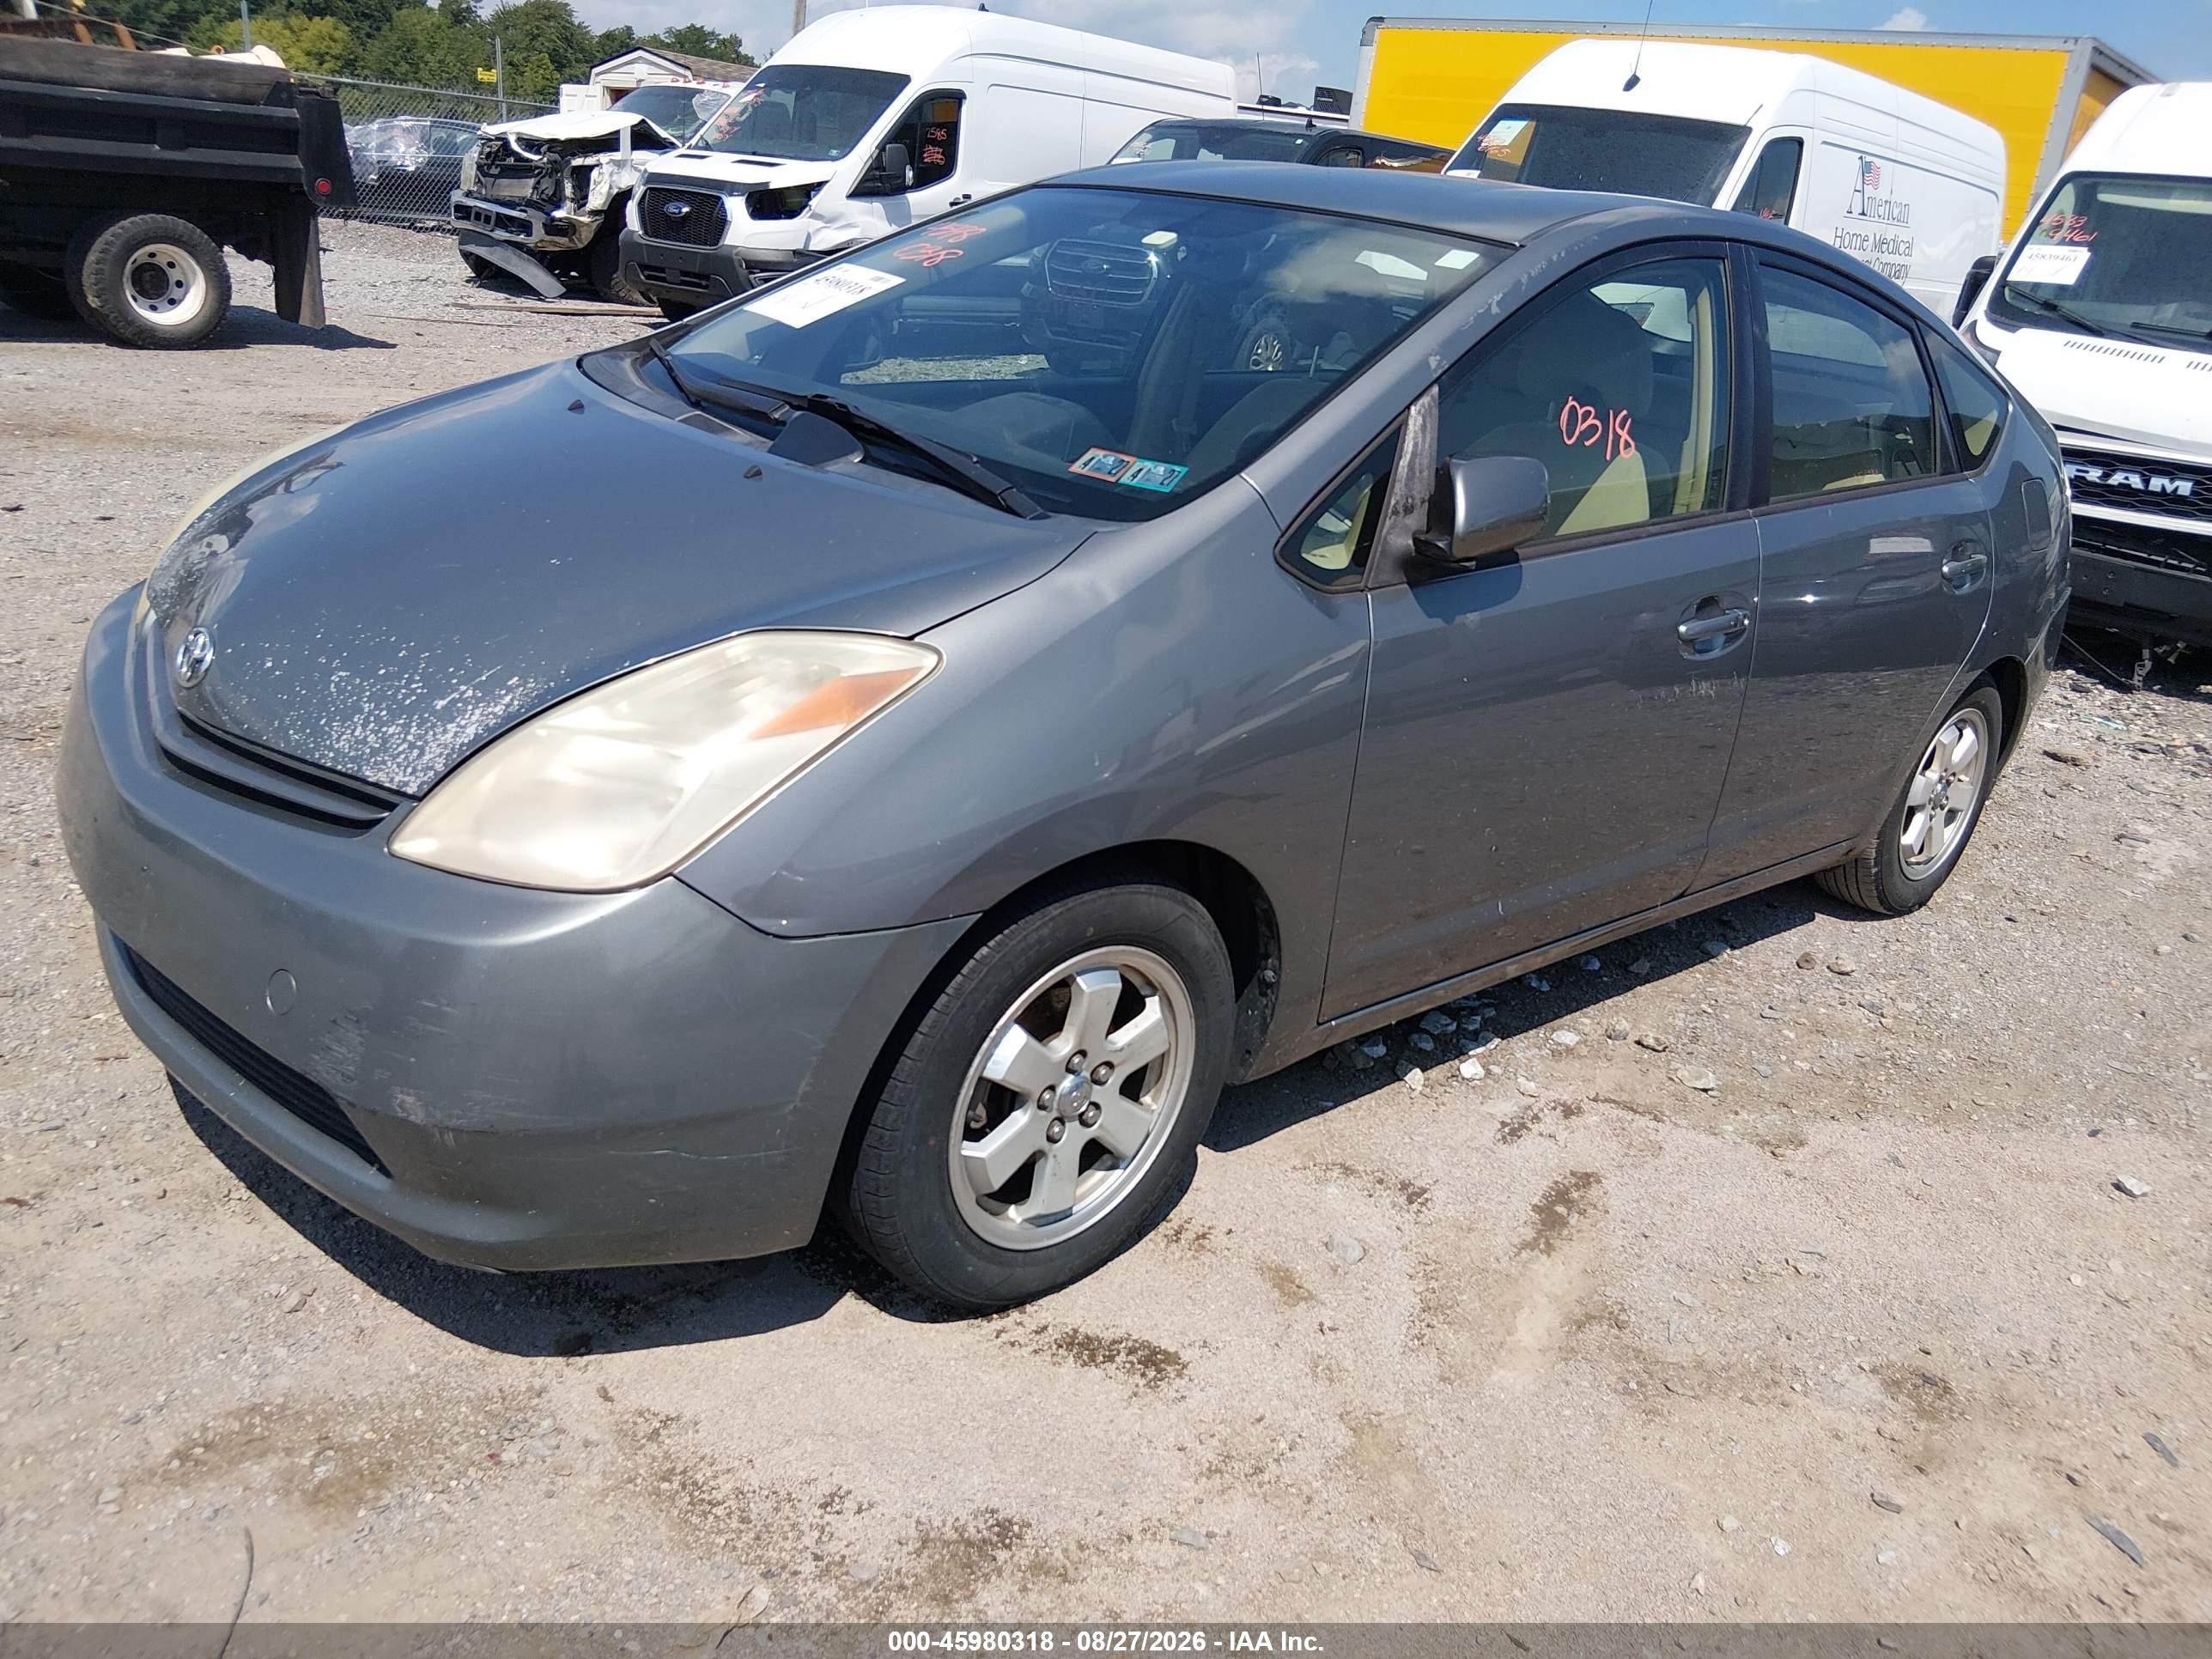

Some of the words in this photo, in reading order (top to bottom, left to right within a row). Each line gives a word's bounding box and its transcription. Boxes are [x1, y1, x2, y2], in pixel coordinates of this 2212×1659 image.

[1846, 155, 1911, 224] American
[1832, 227, 1869, 252] Home
[1870, 232, 1915, 258] Medical
[1559, 395, 1636, 461] 0318
[2064, 464, 2194, 496] RAM
